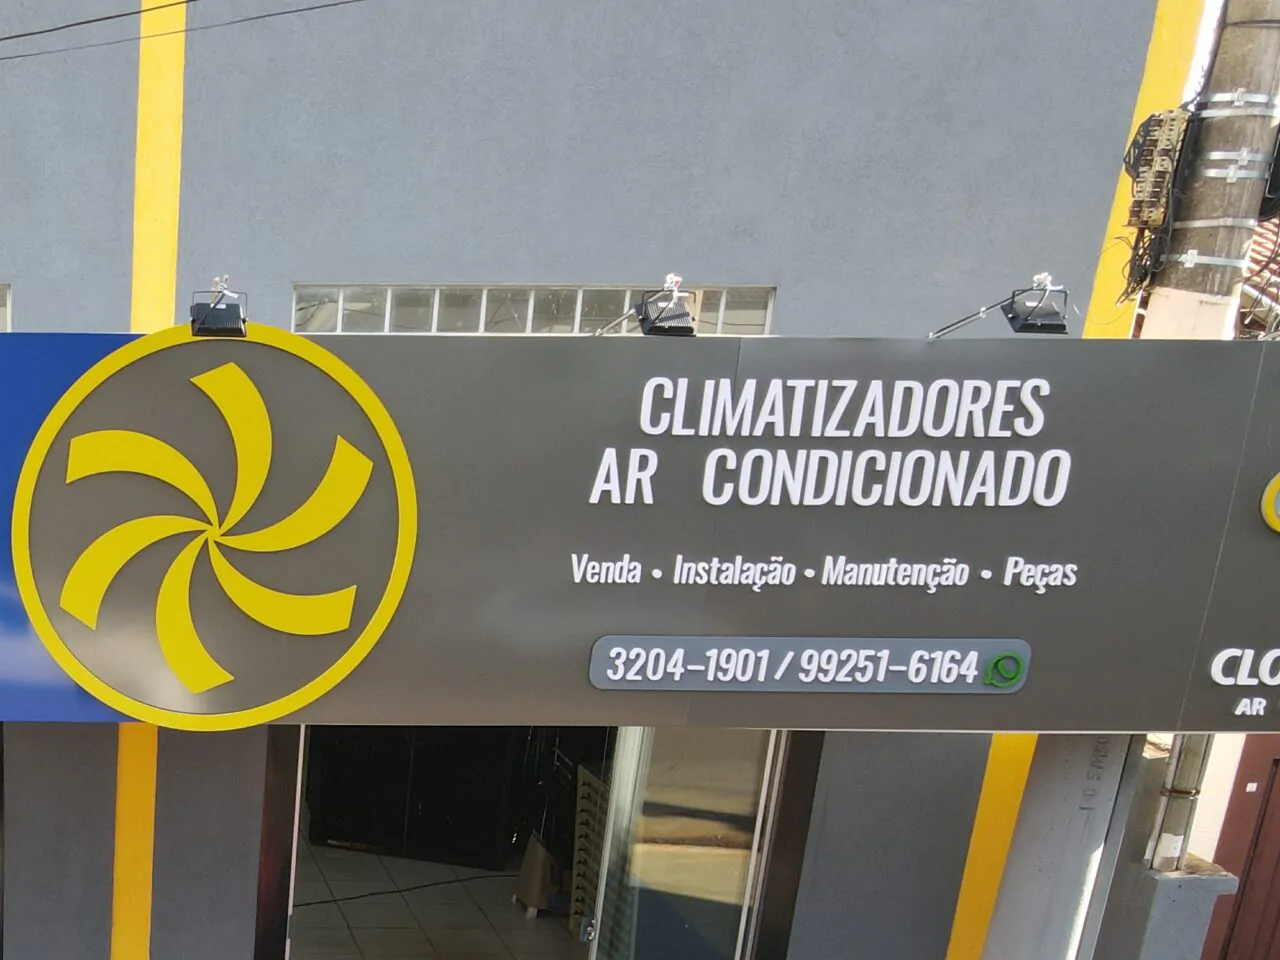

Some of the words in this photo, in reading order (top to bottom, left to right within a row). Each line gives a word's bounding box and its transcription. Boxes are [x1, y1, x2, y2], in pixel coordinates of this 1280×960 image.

[639, 376, 1051, 438] CLIMATIZADORES
[588, 447, 659, 505] AR
[702, 447, 1072, 507] CONDICIONADO
[571, 553, 642, 584] Venda
[673, 553, 797, 593] Instalação
[821, 555, 970, 594] Manutenção
[1003, 556, 1078, 595] Peças
[606, 646, 769, 683] 3204-1901
[798, 648, 980, 685] 99251-6164
[1234, 697, 1268, 716] AR
